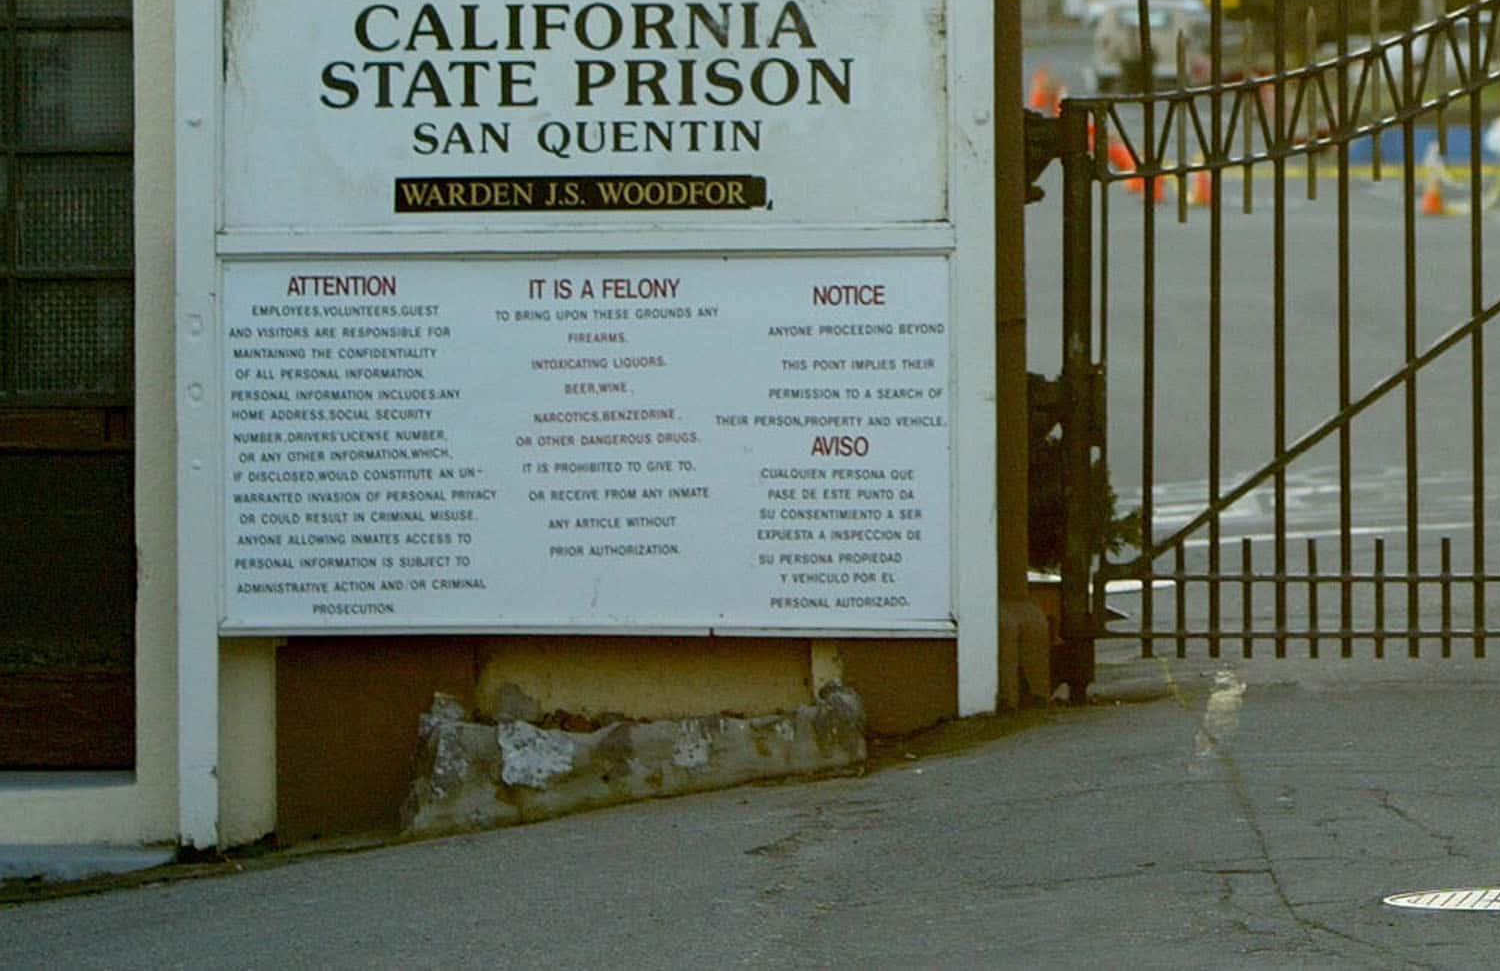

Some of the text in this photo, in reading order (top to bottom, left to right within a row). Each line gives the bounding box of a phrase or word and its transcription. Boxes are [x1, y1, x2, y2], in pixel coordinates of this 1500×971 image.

[355, 2, 816, 51] CALIFORNIA
[320, 58, 854, 109] STATE PRISON
[413, 121, 761, 158] SAN QUENTIN
[402, 179, 746, 208] WARDEN J.S. WOODFOR
[287, 276, 396, 296] ATTENTION
[529, 278, 680, 299] IT IS A FELONY
[813, 285, 885, 306] NOTICE
[495, 307, 718, 322] TO BRING UPON THESE GROUNDS ANY
[229, 326, 450, 338] AND VISITORS ARE RESPONSIBLE FOR
[768, 323, 945, 336] ANYONE PROCEEDING BEYOND
[233, 348, 436, 359] MAINTAINING THE CONFIDENTIALITY
[531, 358, 608, 370] INTOXICATING
[782, 358, 934, 371] THIS POINT IMPLIES THEIR
[235, 368, 250, 380] OF
[256, 369, 274, 380] ALL
[280, 369, 340, 380] PERSONAL
[231, 390, 373, 401] PERSONAL INFORMATION
[768, 388, 944, 399] PERMISSION TO A SEARCH OF
[232, 409, 432, 420] HOME SECURITY
[716, 415, 748, 426] THEIR
[867, 416, 891, 427] AND
[516, 436, 532, 447] OR
[537, 435, 574, 446] OTHER
[580, 434, 652, 446] DANGEROUS
[811, 436, 869, 457] AVISO
[238, 451, 325, 464] OR ANY OTHER
[522, 463, 532, 474] IT
[537, 462, 549, 473] IS
[554, 462, 622, 473] PROHIBITED
[627, 461, 642, 473] TO
[646, 461, 672, 472] GIVE
[233, 471, 243, 482] IF
[363, 468, 432, 481] CONSTITUTE
[439, 469, 454, 478] AN
[832, 469, 886, 480] PERSONA
[890, 470, 914, 480] QUE
[233, 489, 496, 503] WARRANTED INVASION OF PERSONAL PRIVACY
[528, 490, 545, 502] OR
[550, 490, 599, 501] RECEIVE
[605, 489, 636, 500] FROM
[642, 488, 663, 499] ANY
[768, 488, 914, 500] PASE DE ESTE PUNTO DA
[240, 513, 256, 525] OR
[261, 513, 300, 525] COULD
[305, 512, 348, 524] RESULT
[353, 513, 365, 522] IN
[370, 511, 425, 522] CRIMINAL
[759, 508, 922, 520] SU CONSENTIMIENTO A SER
[548, 516, 677, 529] ANY ARTICLE WITHOUT
[237, 533, 472, 546] ANYONE ALLOWING INMATES ACCESS TO
[757, 529, 921, 541] EXPUESTA A INSPECCION DE
[549, 546, 584, 557] PRIOR
[234, 556, 470, 569] PERSONAL INFORMATION IS SUBJECT TO
[758, 552, 903, 565] SU PERSONA PROPIEDAD
[780, 572, 895, 584] Y VEHICULO POR EL
[237, 579, 486, 594] ADMINISTRATIVE ACTION CRIMINAL
[770, 597, 830, 608] PERSONAL
